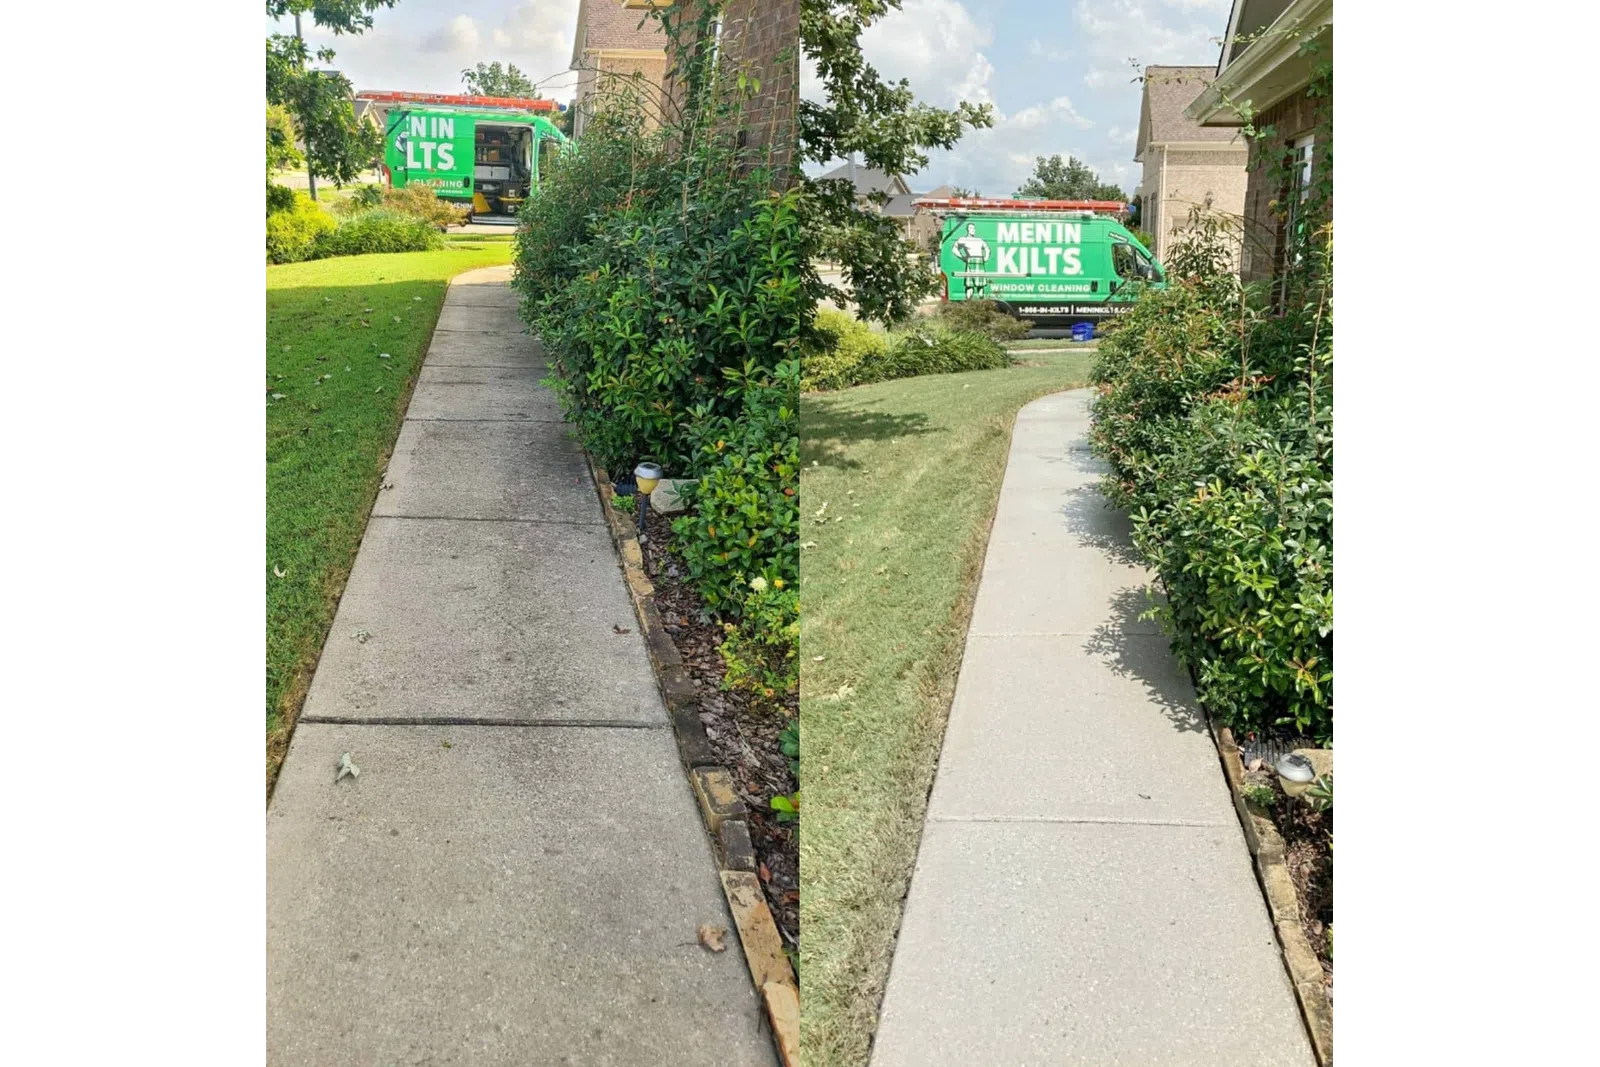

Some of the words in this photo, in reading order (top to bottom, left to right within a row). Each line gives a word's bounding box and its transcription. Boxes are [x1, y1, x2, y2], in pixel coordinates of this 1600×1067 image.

[431, 117, 454, 139] IN
[997, 222, 1051, 243] MEN
[1058, 223, 1081, 244] IN
[990, 283, 1035, 292] WINDOW
[1038, 284, 1090, 292] CLEANING
